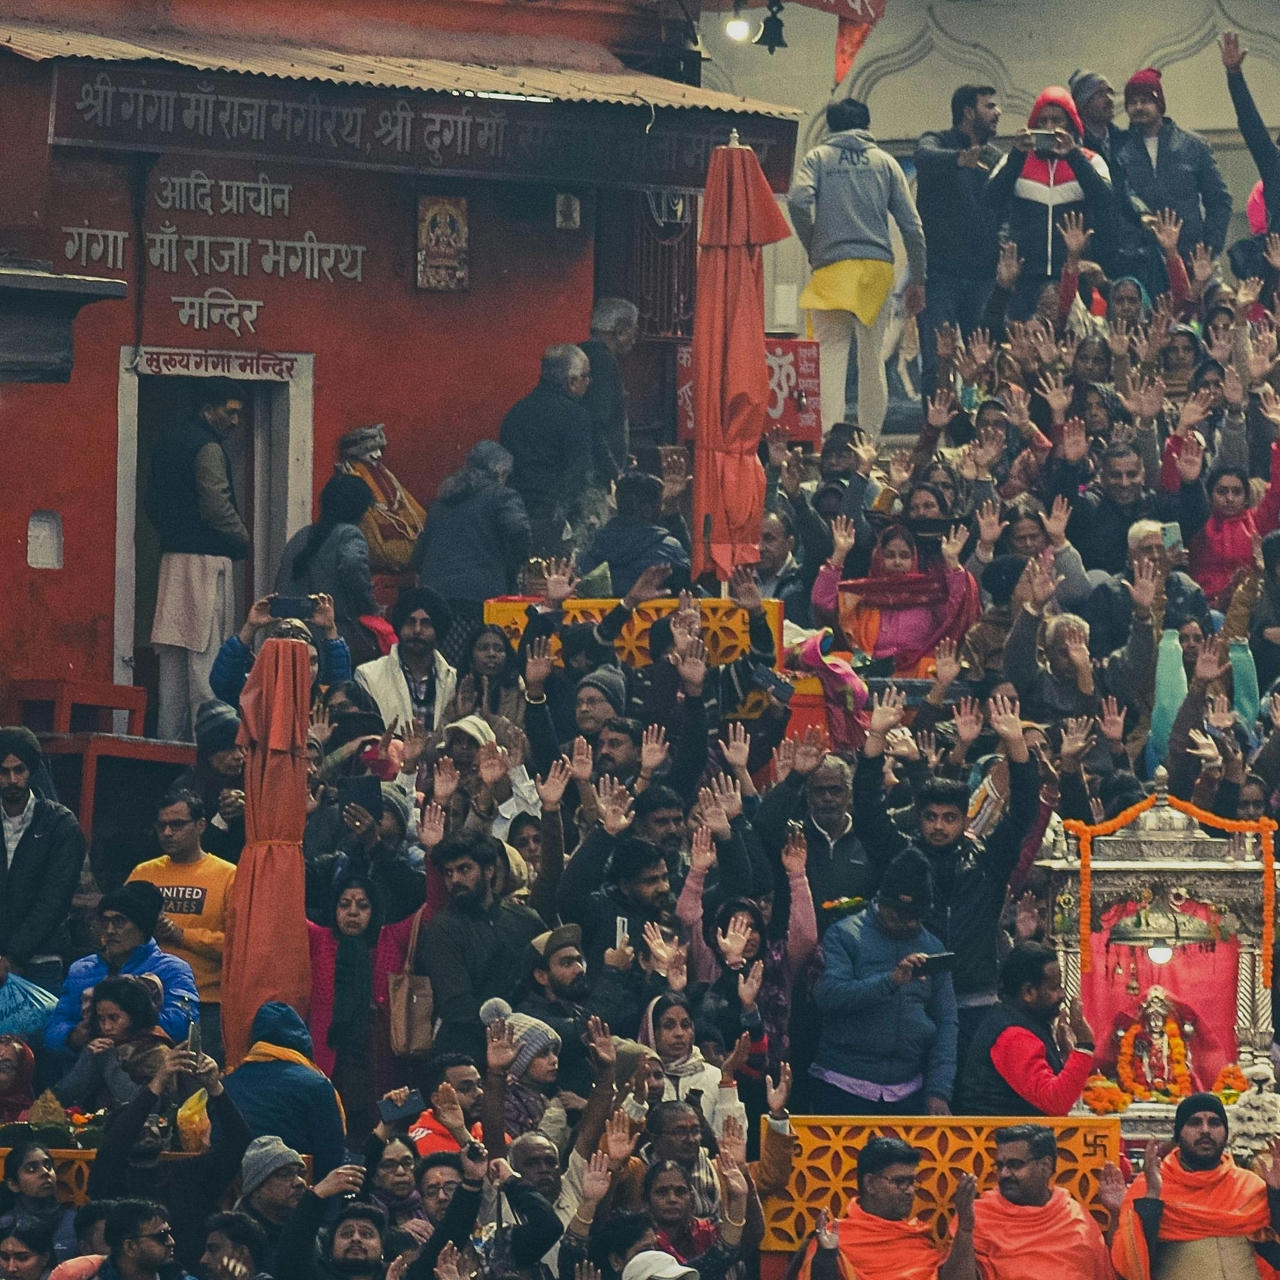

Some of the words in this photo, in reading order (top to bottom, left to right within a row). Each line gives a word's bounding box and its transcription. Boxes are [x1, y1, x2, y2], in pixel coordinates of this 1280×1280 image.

[76, 73, 116, 127] श्री
[119, 79, 177, 133] गंगा
[180, 80, 217, 136] माँ
[217, 93, 269, 141] राजा
[373, 100, 415, 152] श्री
[421, 106, 477, 166] दुर्गा
[155, 170, 214, 216] आदि
[219, 172, 293, 218] प्राचीन
[62, 219, 129, 270] गंगा
[146, 220, 178, 273] माँ
[182, 236, 252, 276] राजा
[258, 230, 367, 282] भगीरथ
[171, 286, 263, 337] मन्दिर
[191, 350, 233, 373] गंगा
[234, 352, 298, 379] मन्दिर
[160, 887, 202, 899] NITED
[164, 901, 197, 913] ATES
